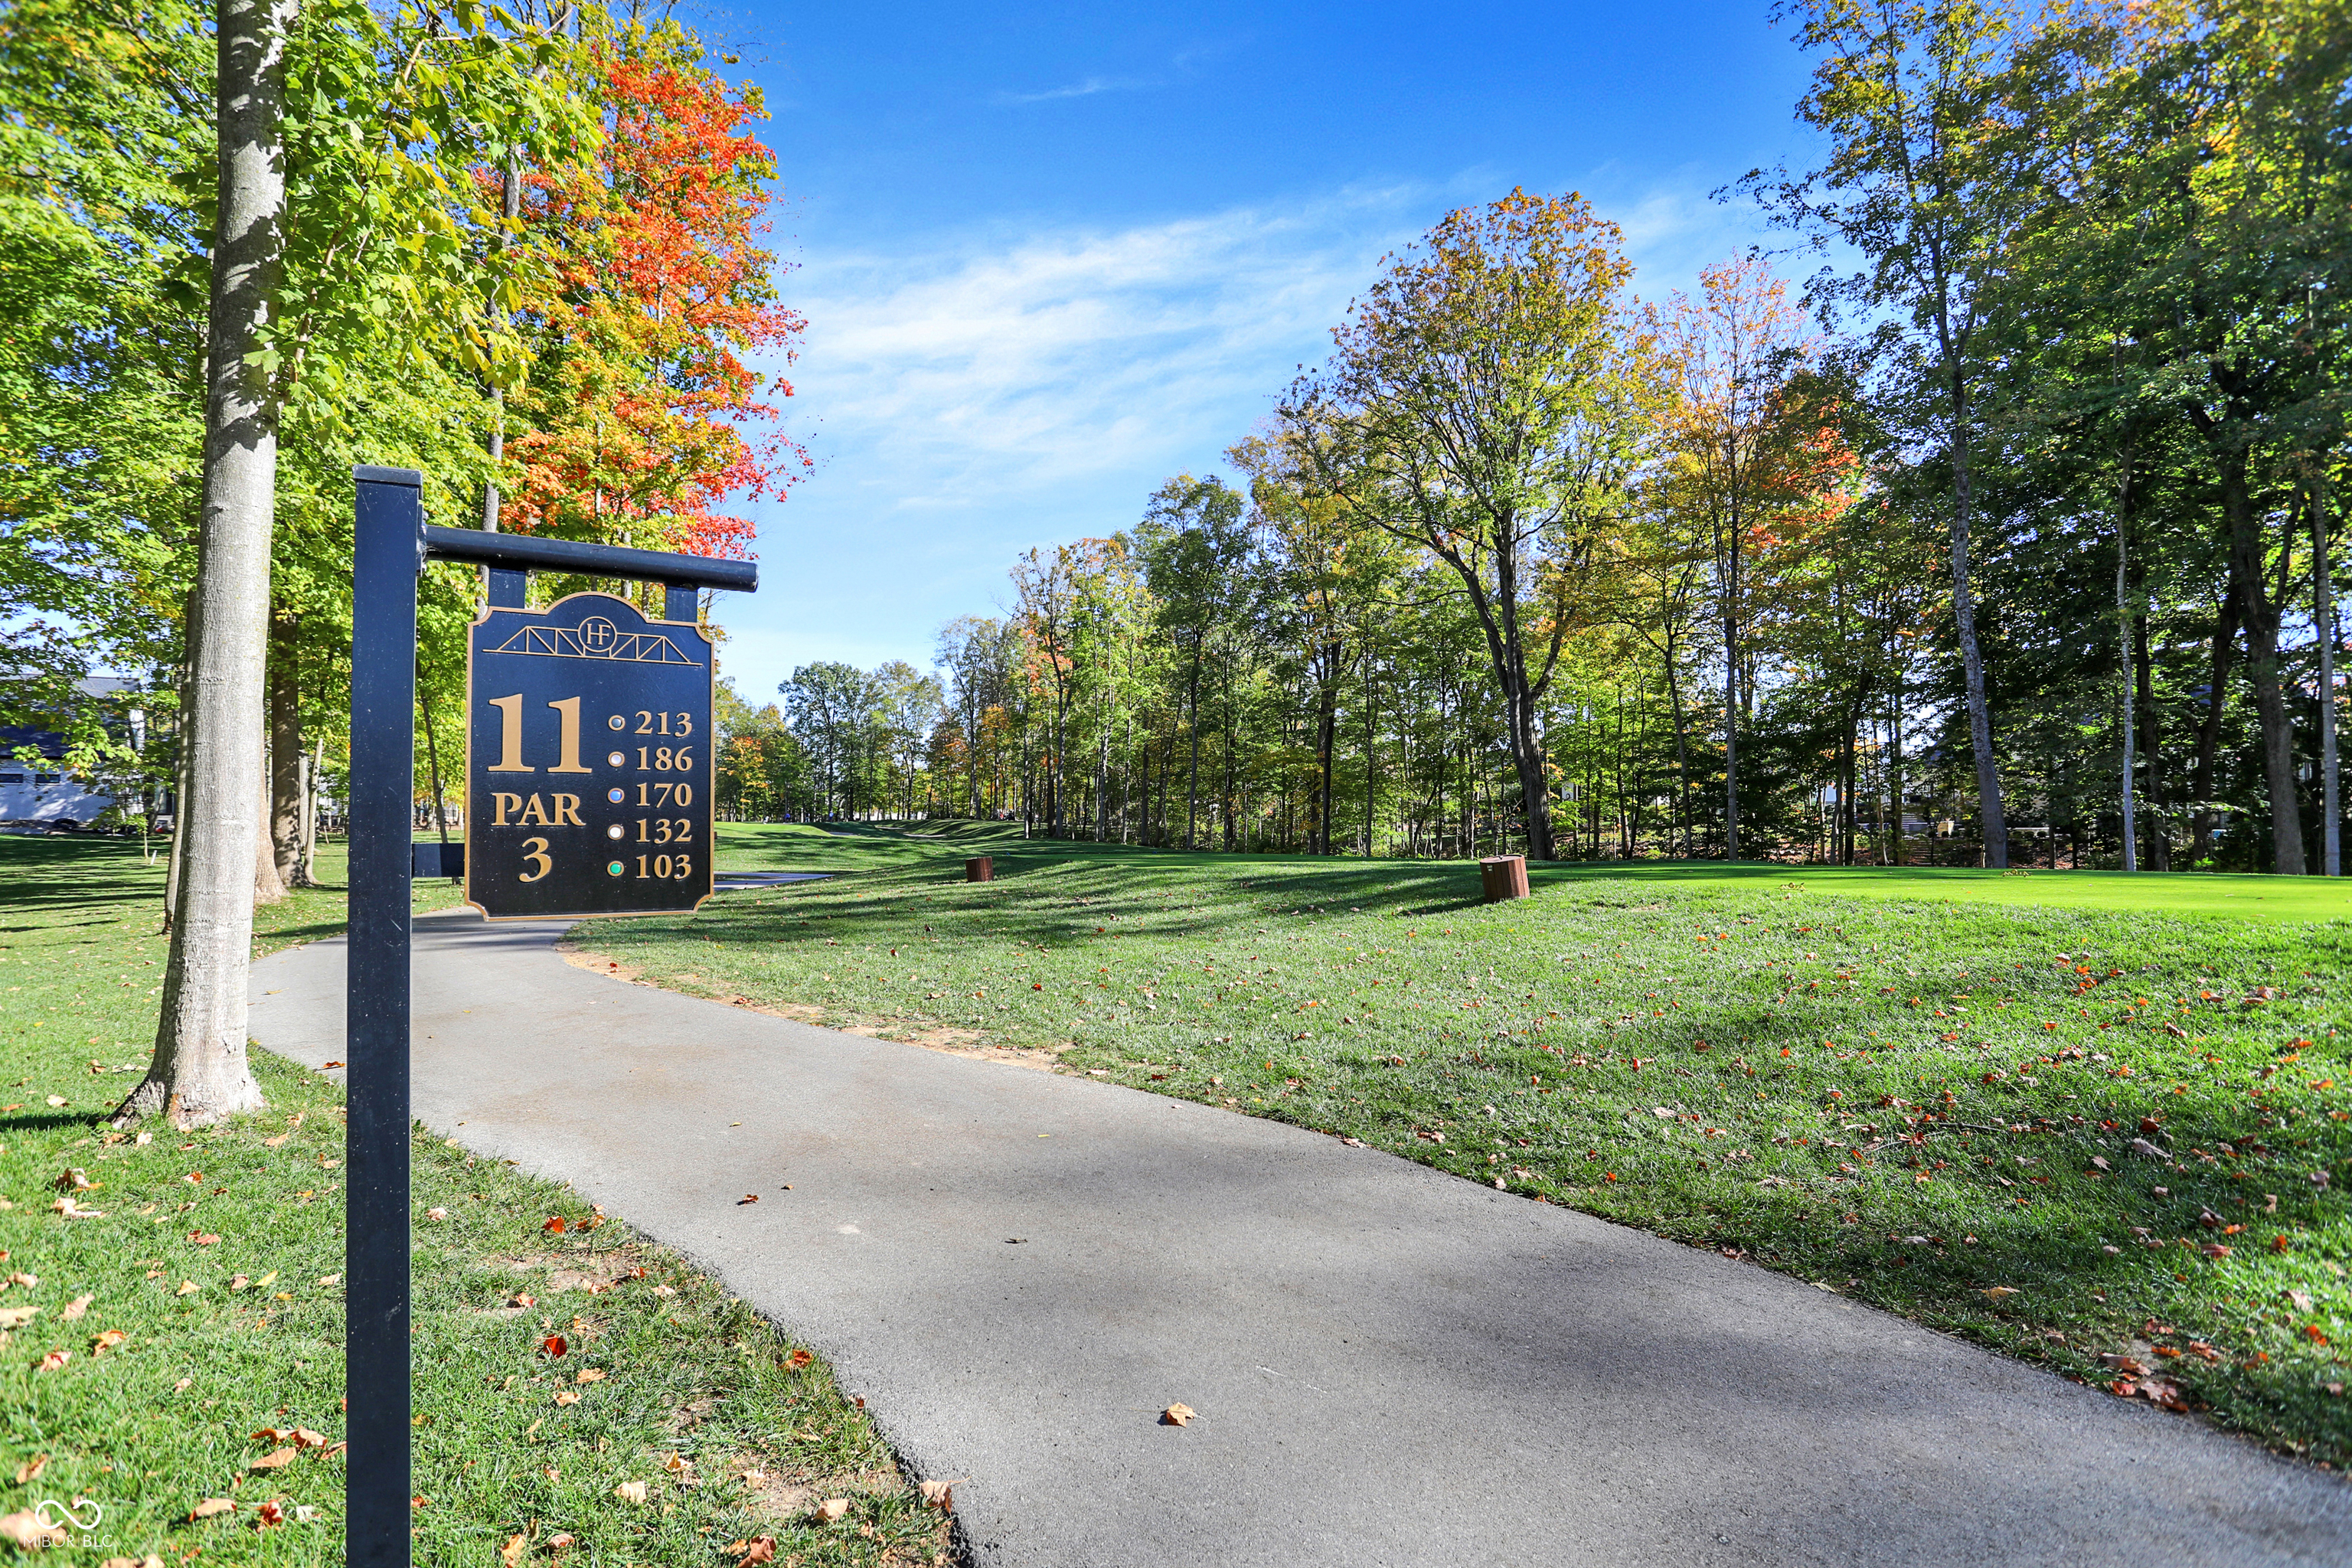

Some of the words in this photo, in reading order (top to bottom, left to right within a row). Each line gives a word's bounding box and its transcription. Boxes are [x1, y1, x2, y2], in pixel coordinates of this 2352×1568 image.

[488, 694, 592, 773] 11
[635, 710, 692, 737] 213
[636, 746, 693, 771] 186
[636, 782, 692, 808] 170
[491, 792, 586, 826] PAR
[636, 818, 692, 844] 132
[519, 837, 553, 883] 3
[635, 854, 691, 880] 103
